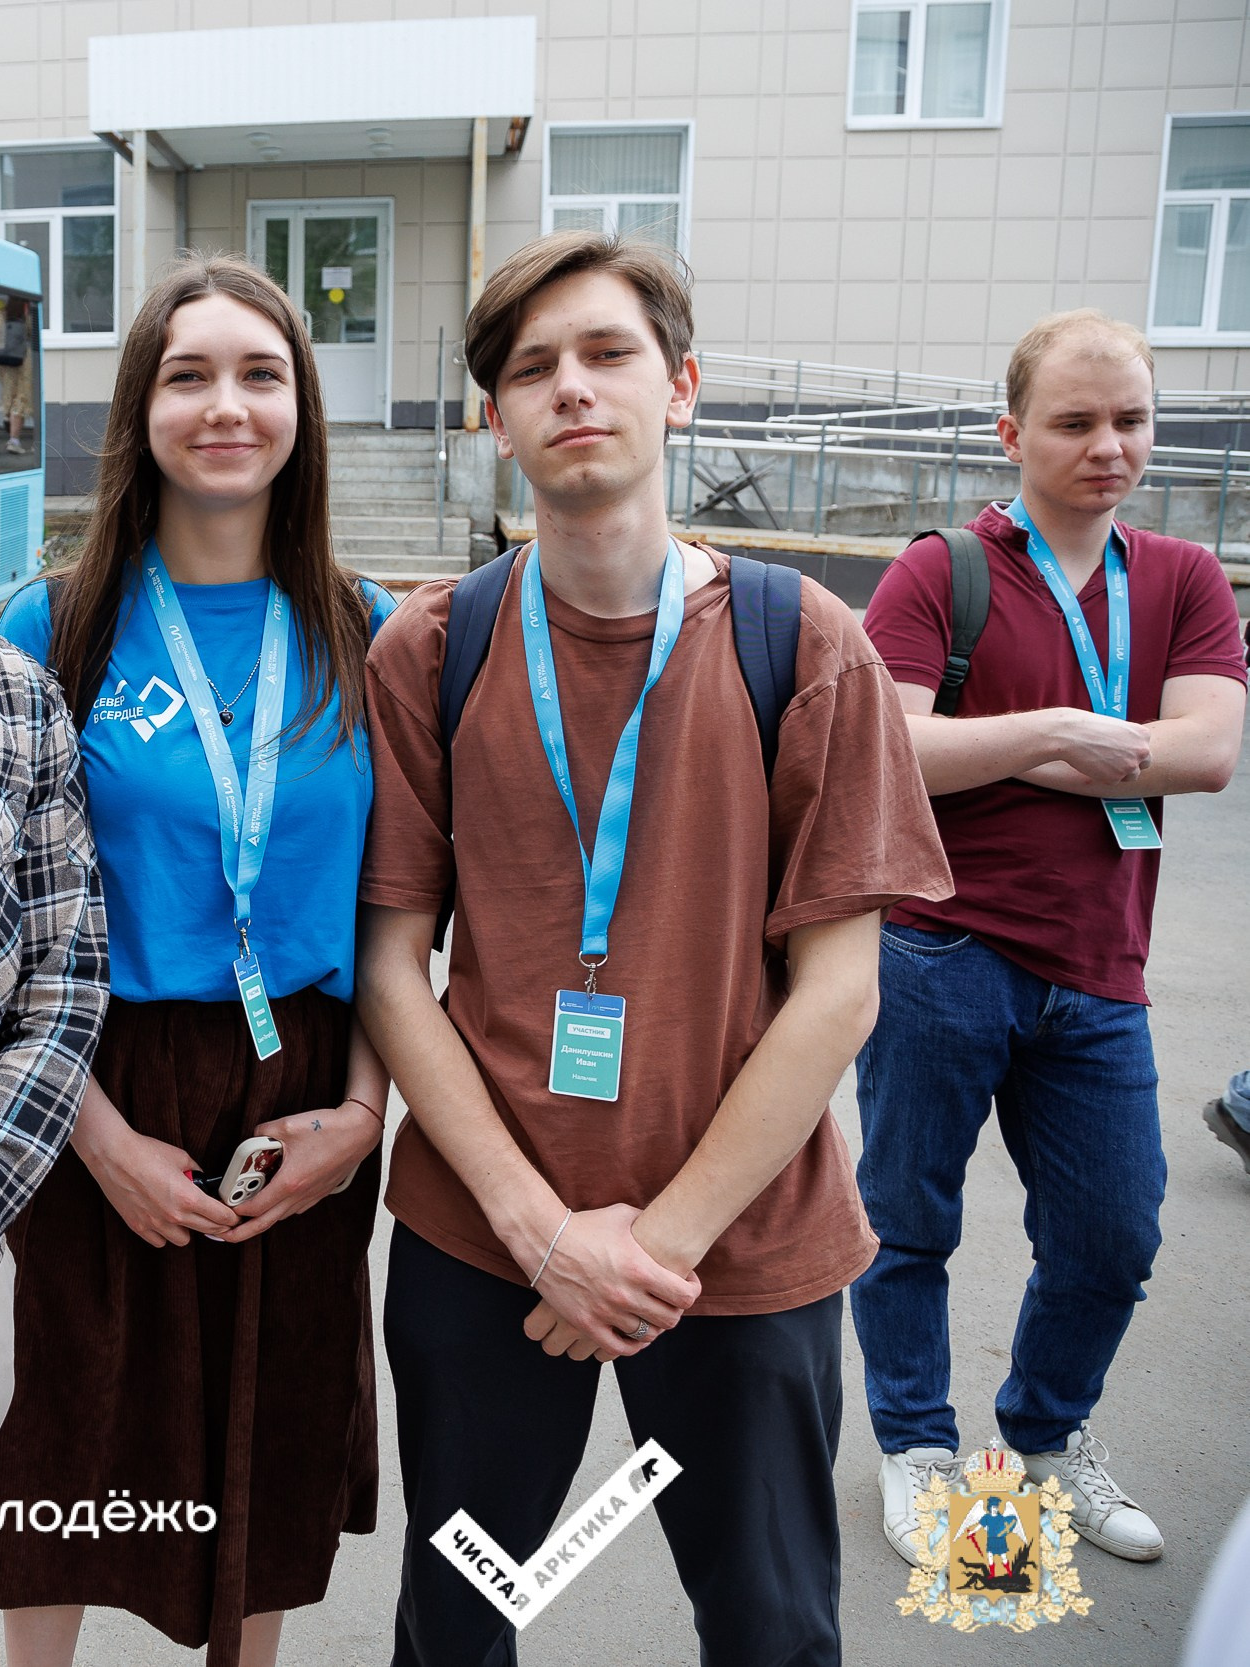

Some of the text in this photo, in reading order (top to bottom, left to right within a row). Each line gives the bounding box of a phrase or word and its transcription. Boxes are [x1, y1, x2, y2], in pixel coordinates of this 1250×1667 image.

[93, 695, 125, 708] СЕВЕР
[93, 706, 144, 724] В СЕРДЦЕ
[572, 1026, 606, 1036] УЧАСТНИК
[561, 1045, 613, 1058] Данилушкин
[576, 1057, 597, 1068] Иван
[572, 1073, 598, 1082] Нальчик
